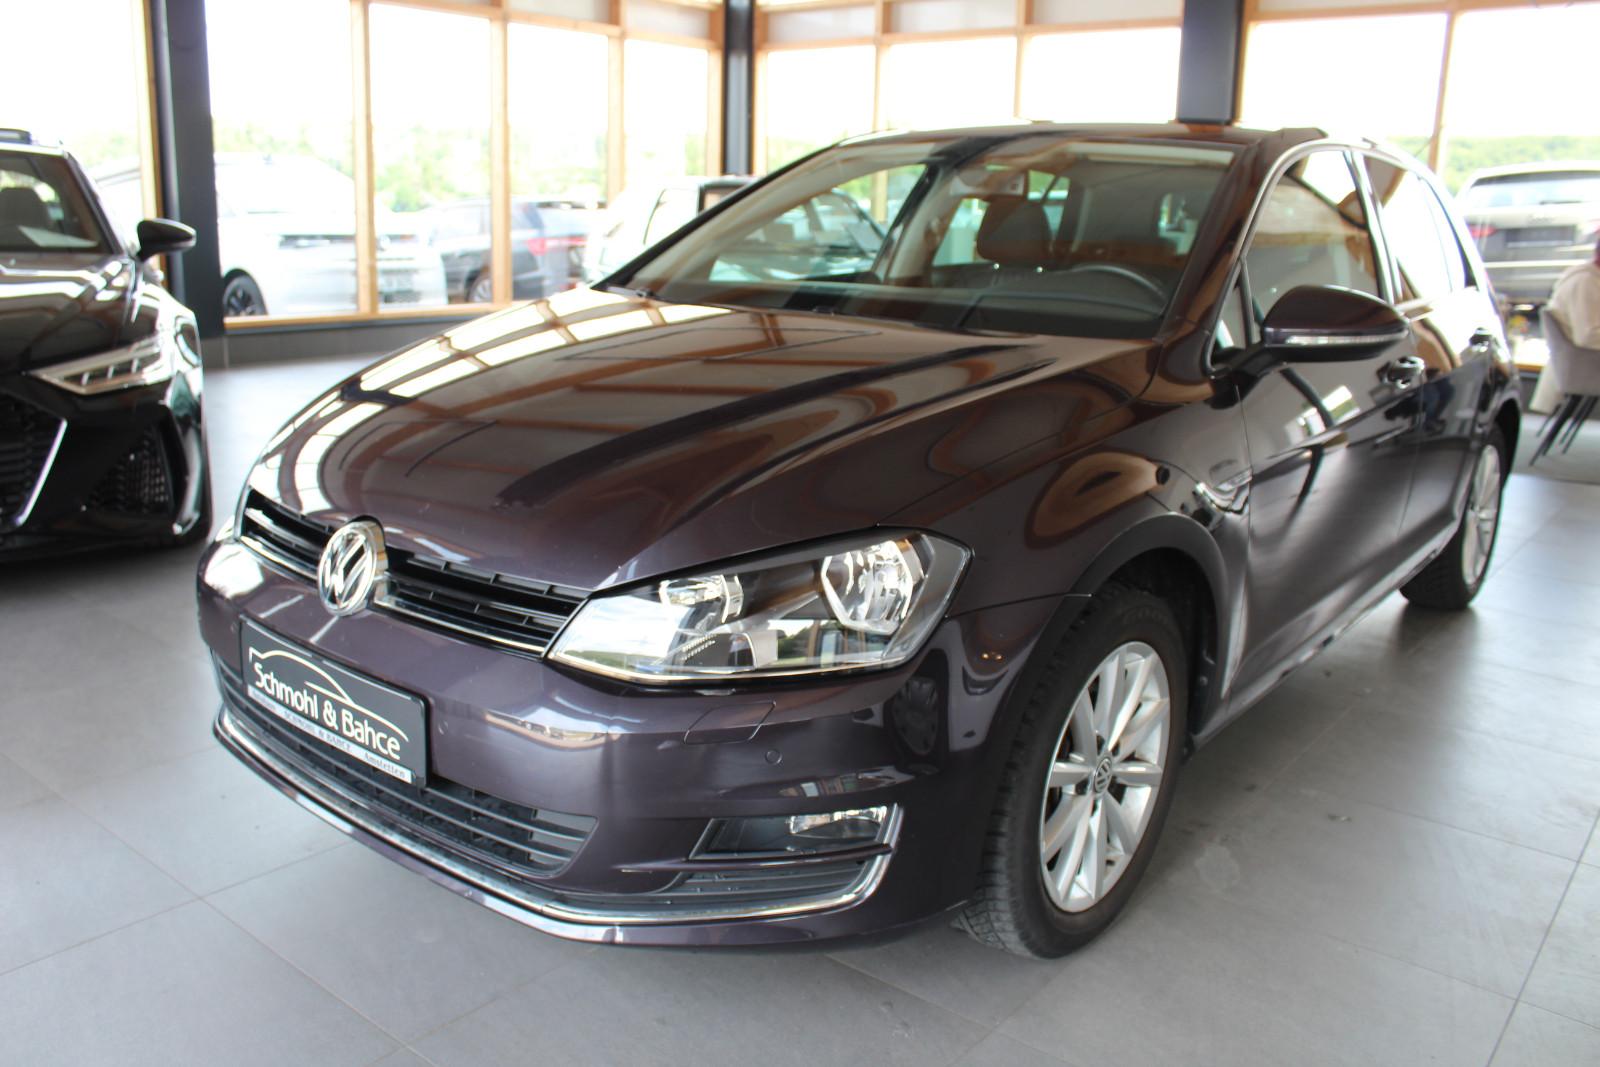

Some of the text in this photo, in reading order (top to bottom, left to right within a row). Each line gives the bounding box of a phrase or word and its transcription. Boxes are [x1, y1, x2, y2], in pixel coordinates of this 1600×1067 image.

[254, 662, 319, 720] Schmohl
[323, 700, 339, 731] &
[341, 708, 401, 760] Bahce
